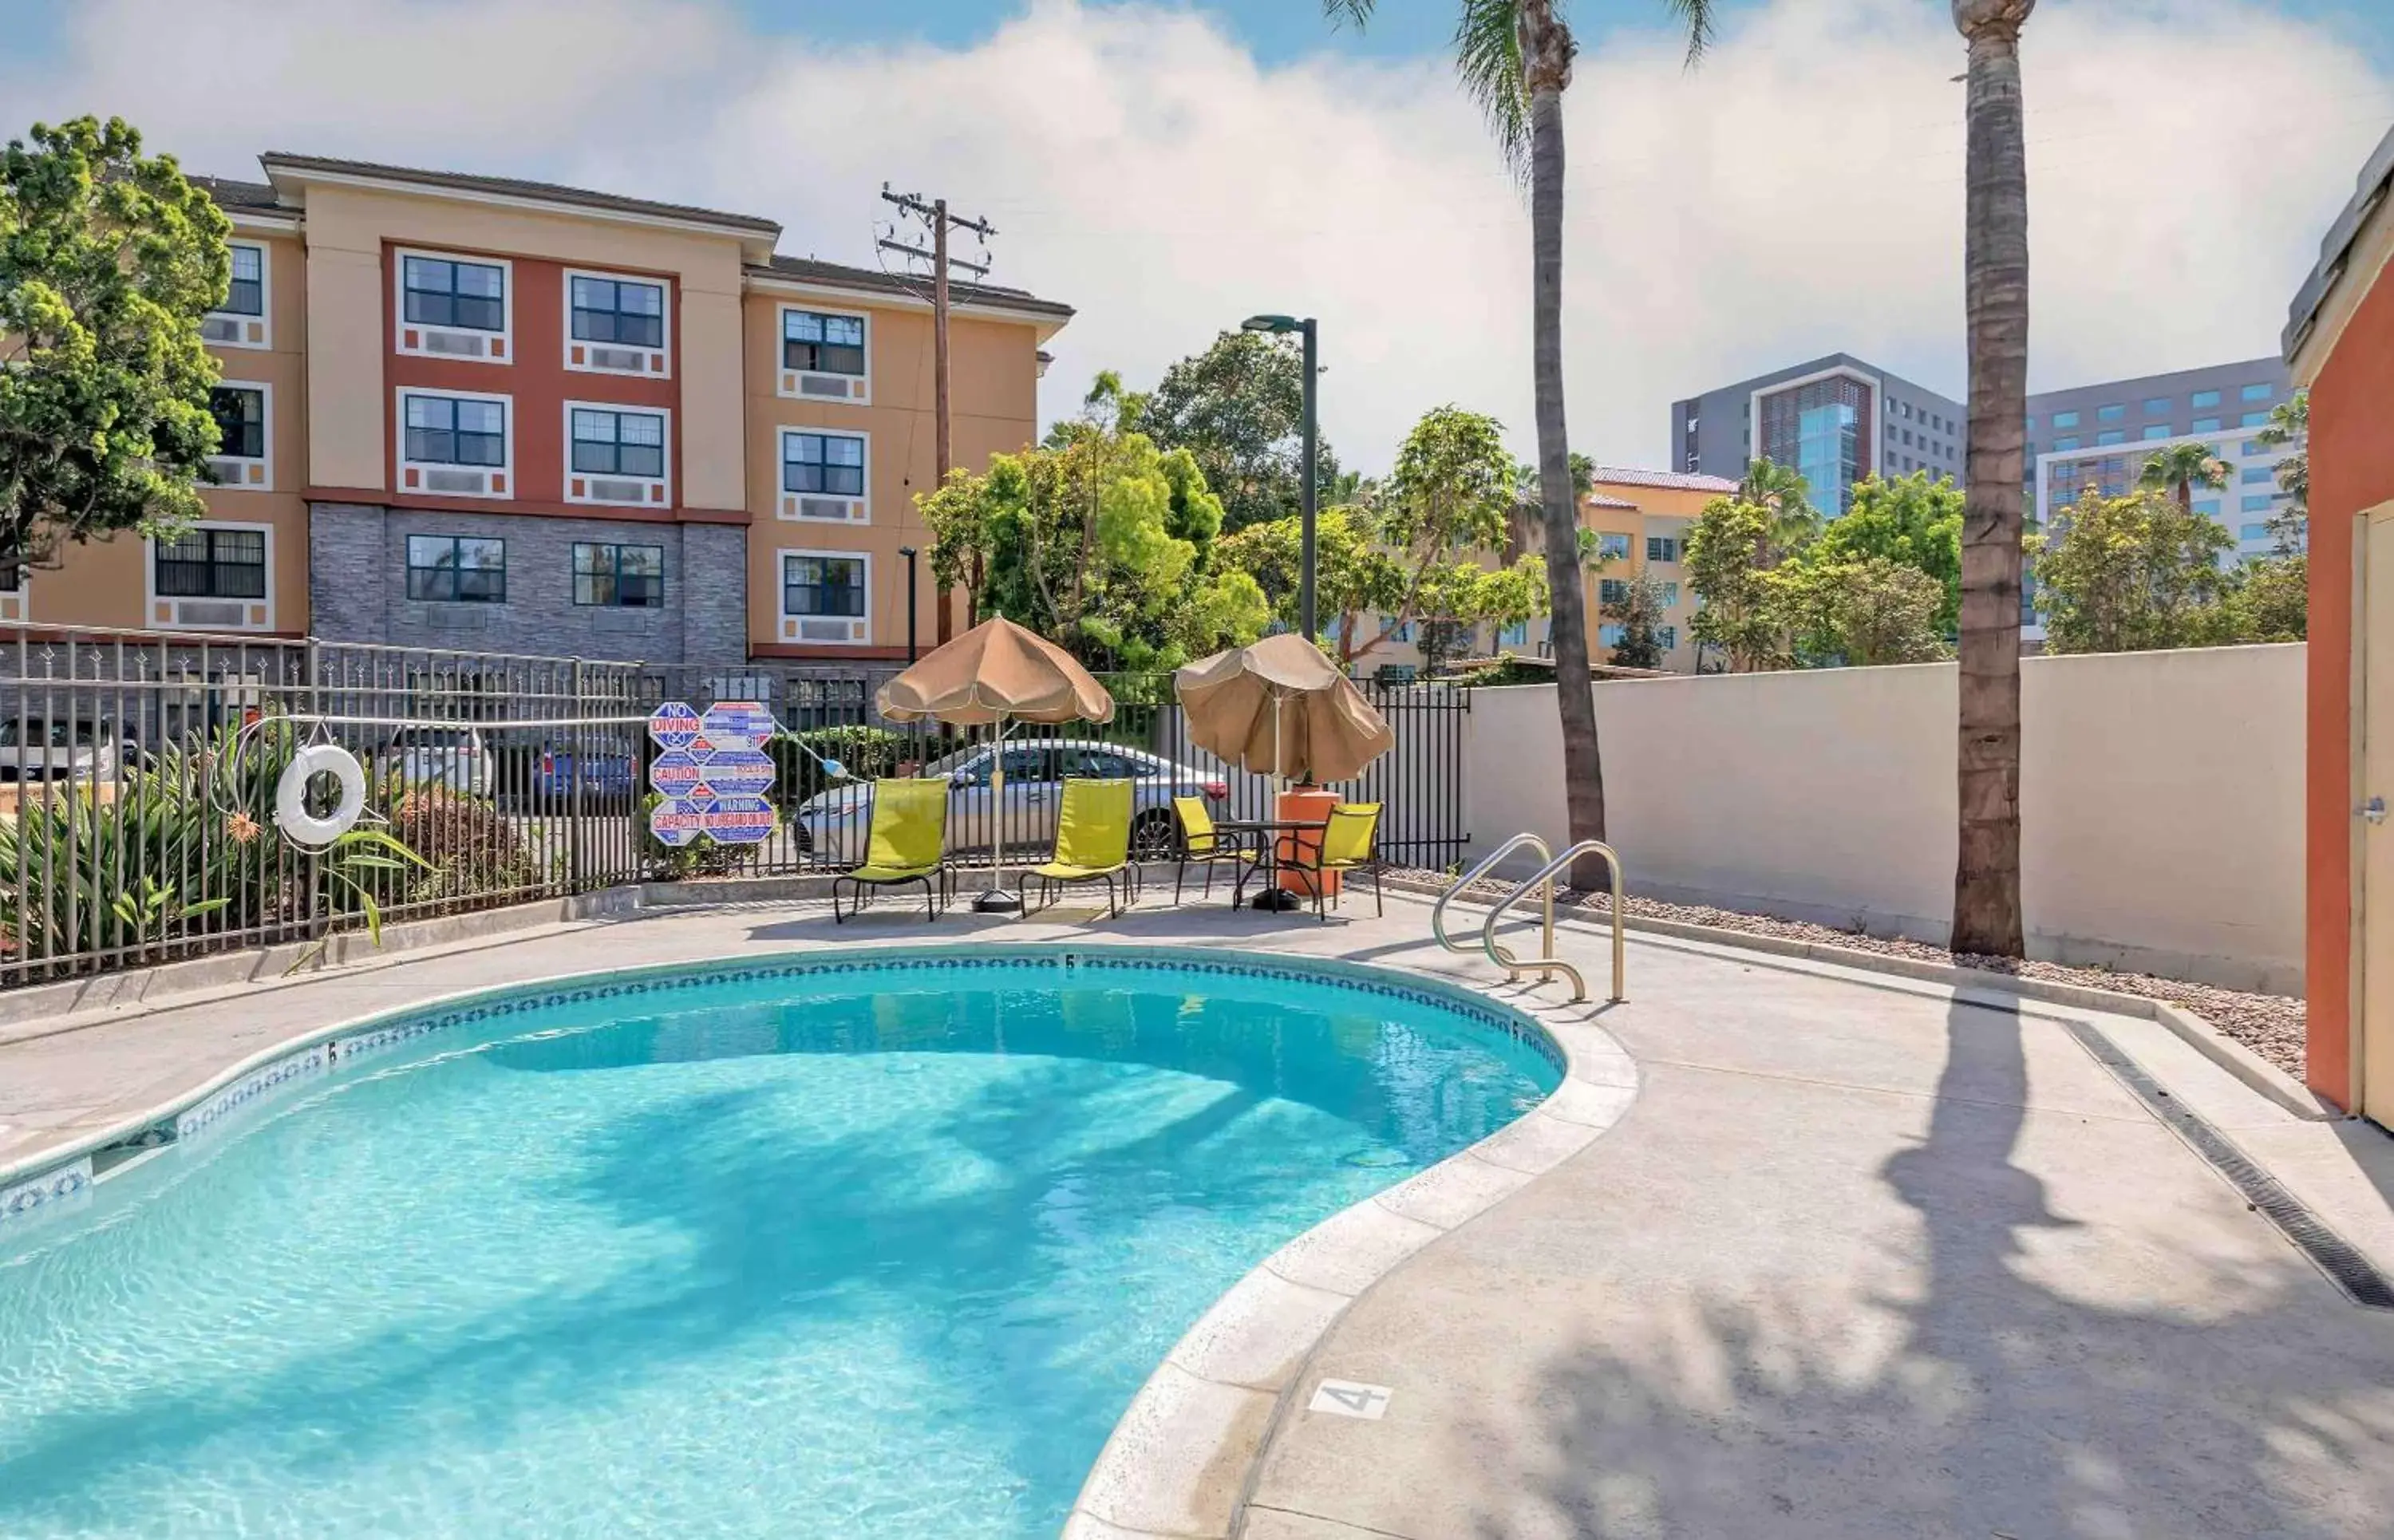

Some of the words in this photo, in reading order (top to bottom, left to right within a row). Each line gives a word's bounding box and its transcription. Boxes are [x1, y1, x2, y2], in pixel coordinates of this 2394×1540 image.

[668, 704, 686, 717] NO
[653, 718, 699, 731] DIVING
[654, 767, 700, 780] CAUTION
[720, 799, 760, 811] WARNING
[654, 815, 700, 828] CAPACITY
[1321, 1385, 1385, 1412] 4
